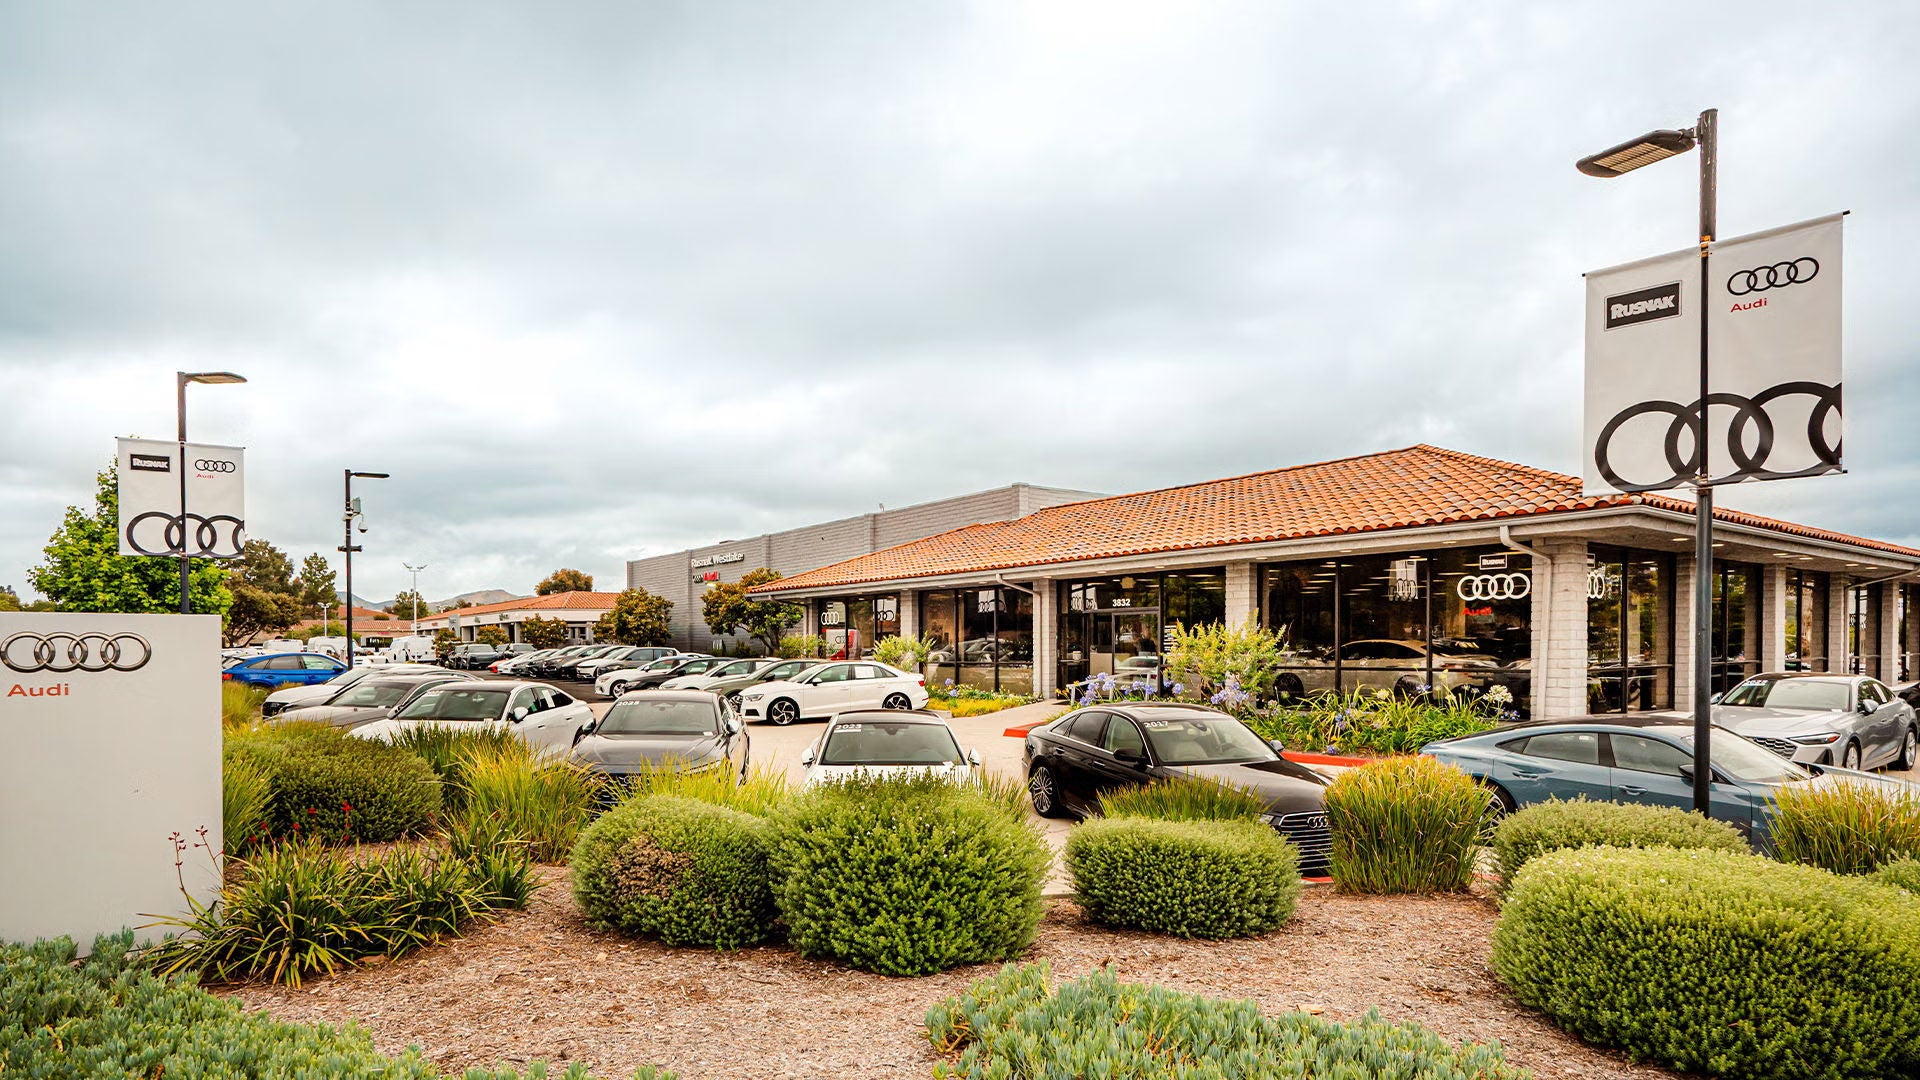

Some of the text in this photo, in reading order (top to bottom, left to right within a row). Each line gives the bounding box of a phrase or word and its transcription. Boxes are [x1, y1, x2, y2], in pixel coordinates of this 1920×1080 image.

[1610, 294, 1675, 320] RUSNAK
[1730, 298, 1768, 313] Audi
[132, 458, 168, 469] RUSNAK
[1112, 598, 1131, 607] 3832
[1462, 606, 1492, 616] Audi
[7, 683, 69, 697] Audi
[1143, 720, 1169, 728] 2017
